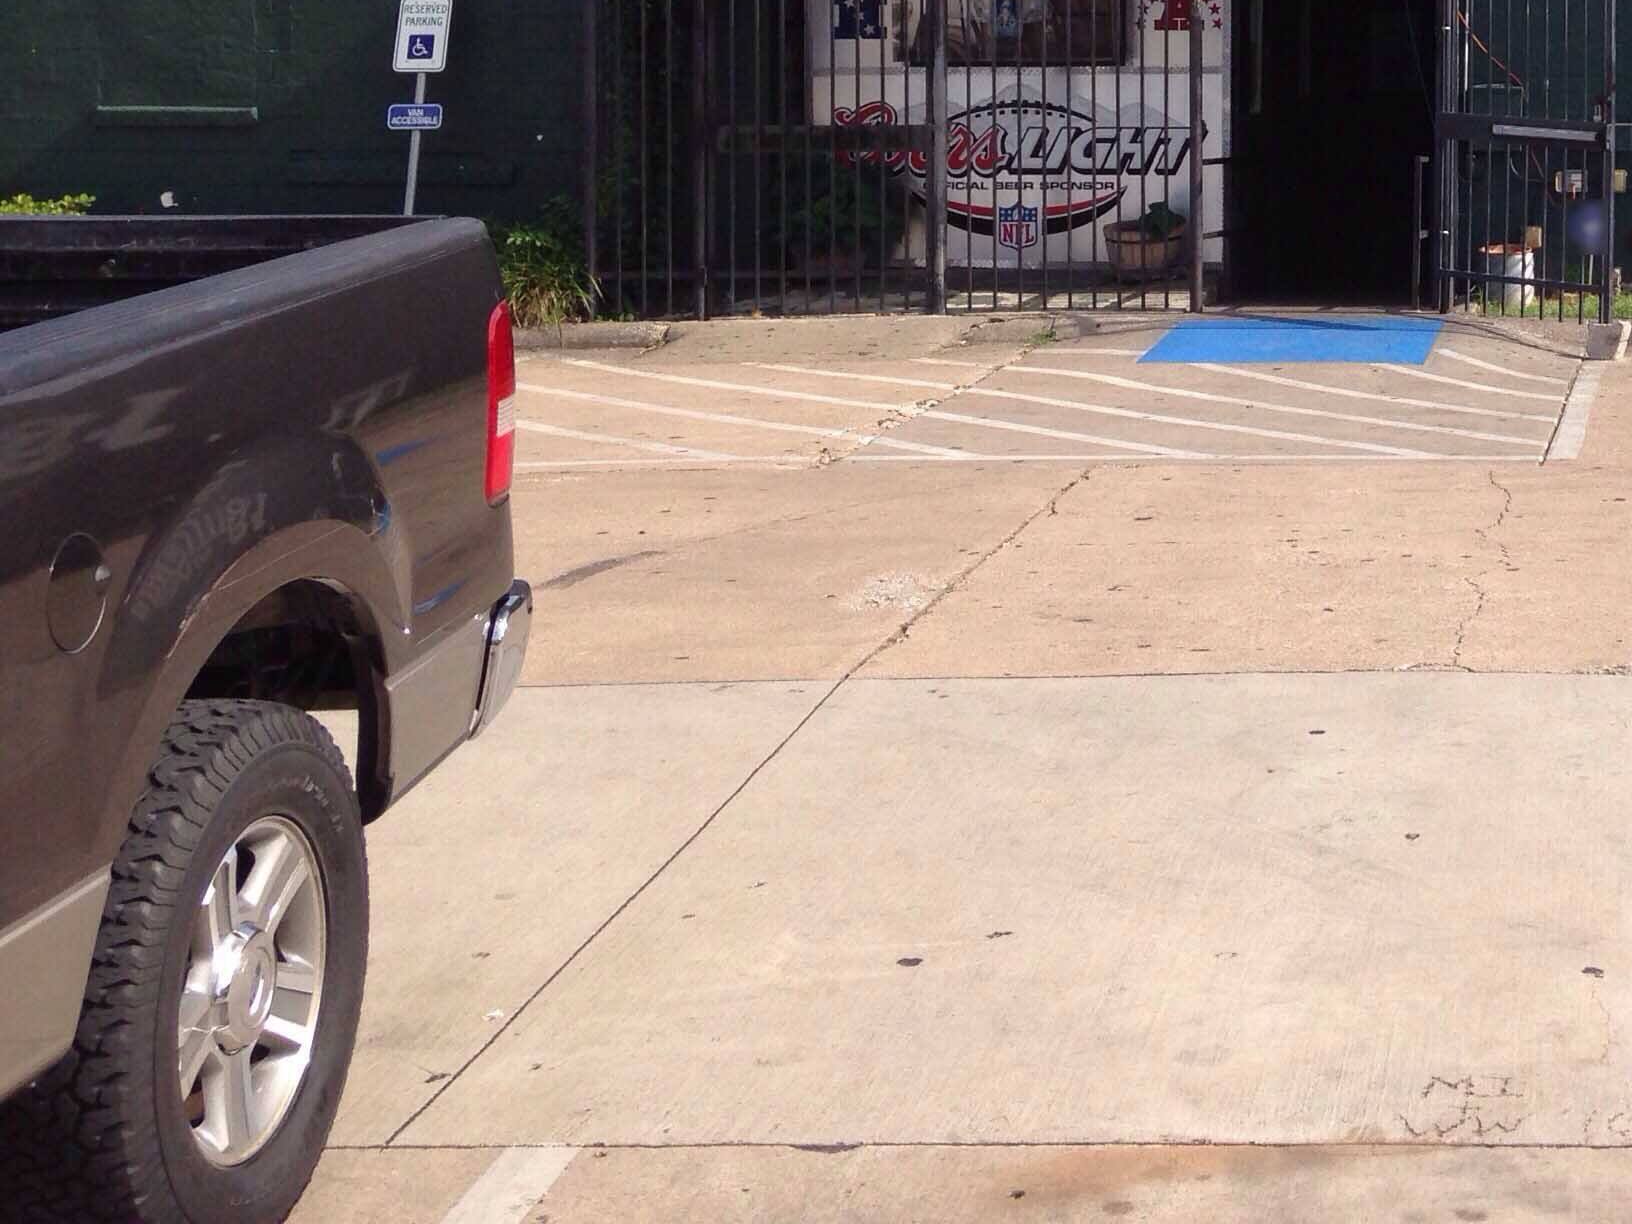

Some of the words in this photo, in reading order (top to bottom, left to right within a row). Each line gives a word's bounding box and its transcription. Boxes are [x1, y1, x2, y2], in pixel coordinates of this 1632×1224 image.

[404, 4, 447, 15] RESERVED
[405, 16, 443, 26] PARKING
[1003, 125, 1207, 176] LIGHT
[1040, 181, 1115, 191] SPONSOR
